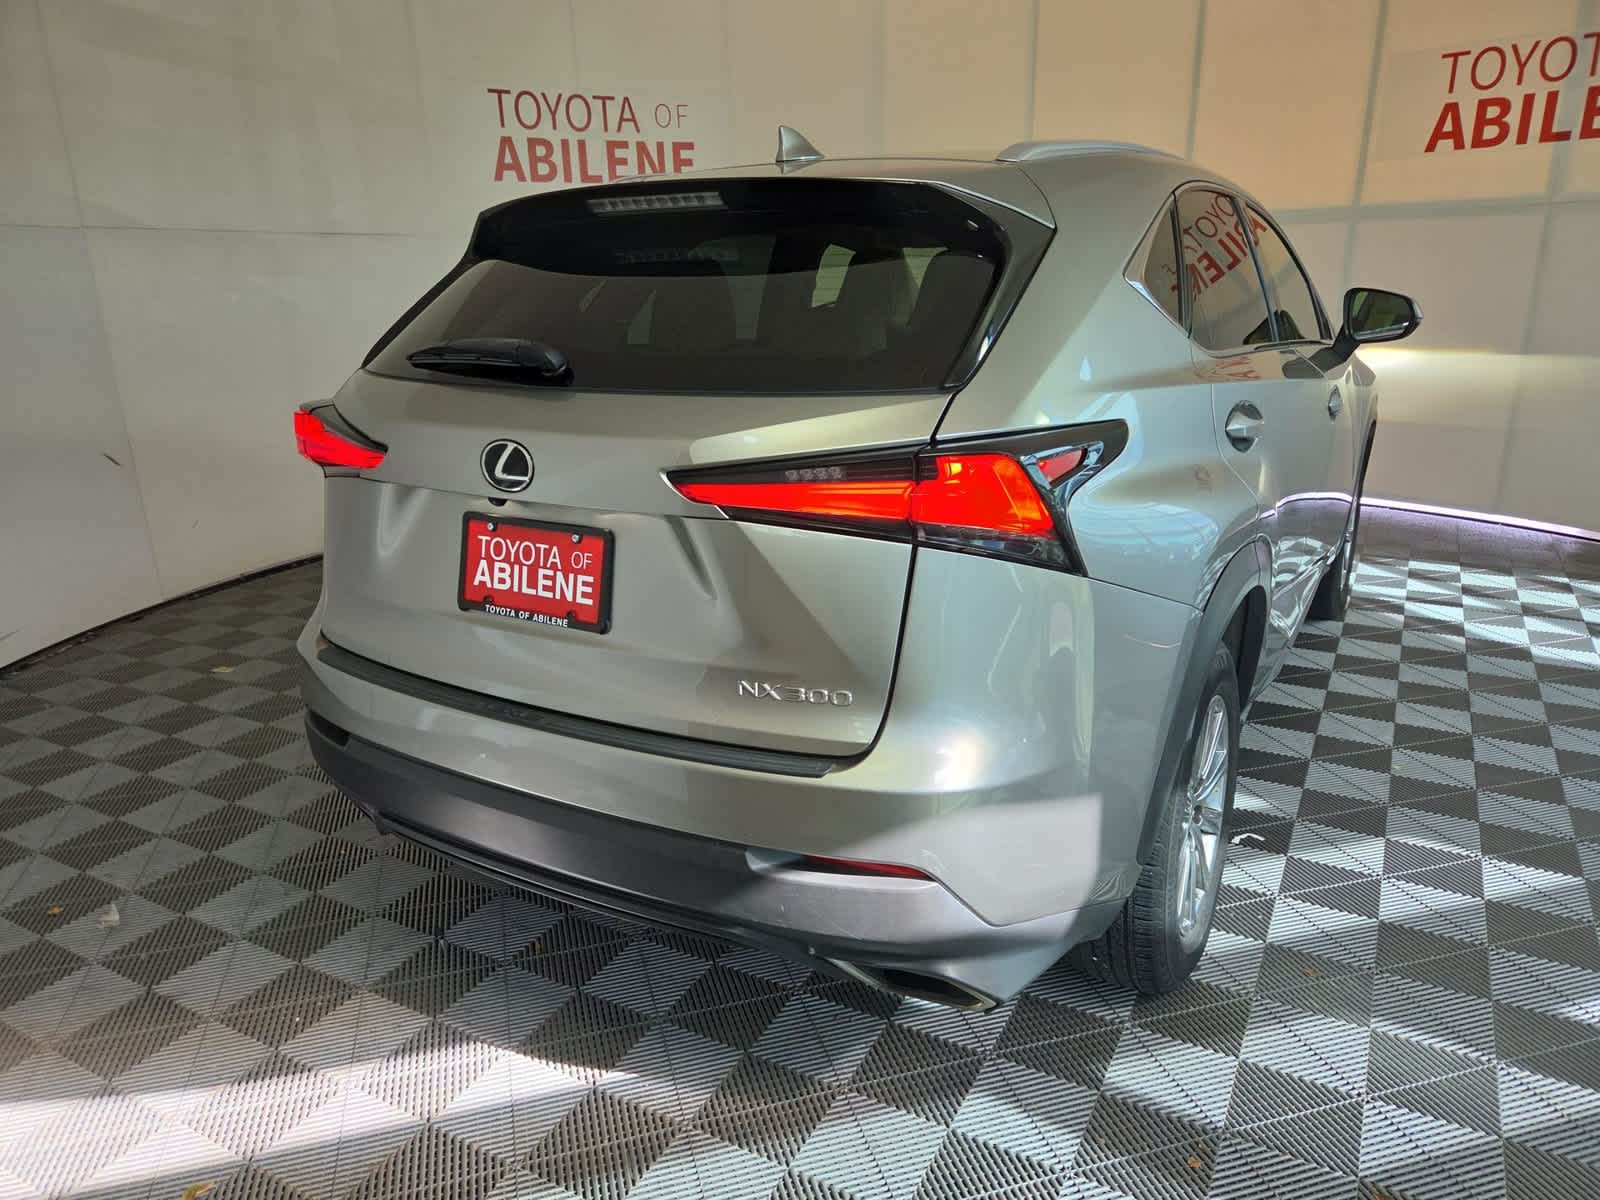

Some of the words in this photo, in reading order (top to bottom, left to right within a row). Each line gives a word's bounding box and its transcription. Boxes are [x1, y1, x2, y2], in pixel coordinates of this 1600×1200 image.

[487, 88, 641, 133] TOYOTA
[654, 103, 689, 129] OF
[494, 135, 695, 184] ABILENE
[477, 535, 562, 570] TOYOTA
[571, 551, 593, 570] OF
[473, 559, 595, 606] ABILENE
[485, 604, 515, 617] TOYOTA
[518, 611, 530, 620] OF
[533, 613, 569, 628] ABILENE
